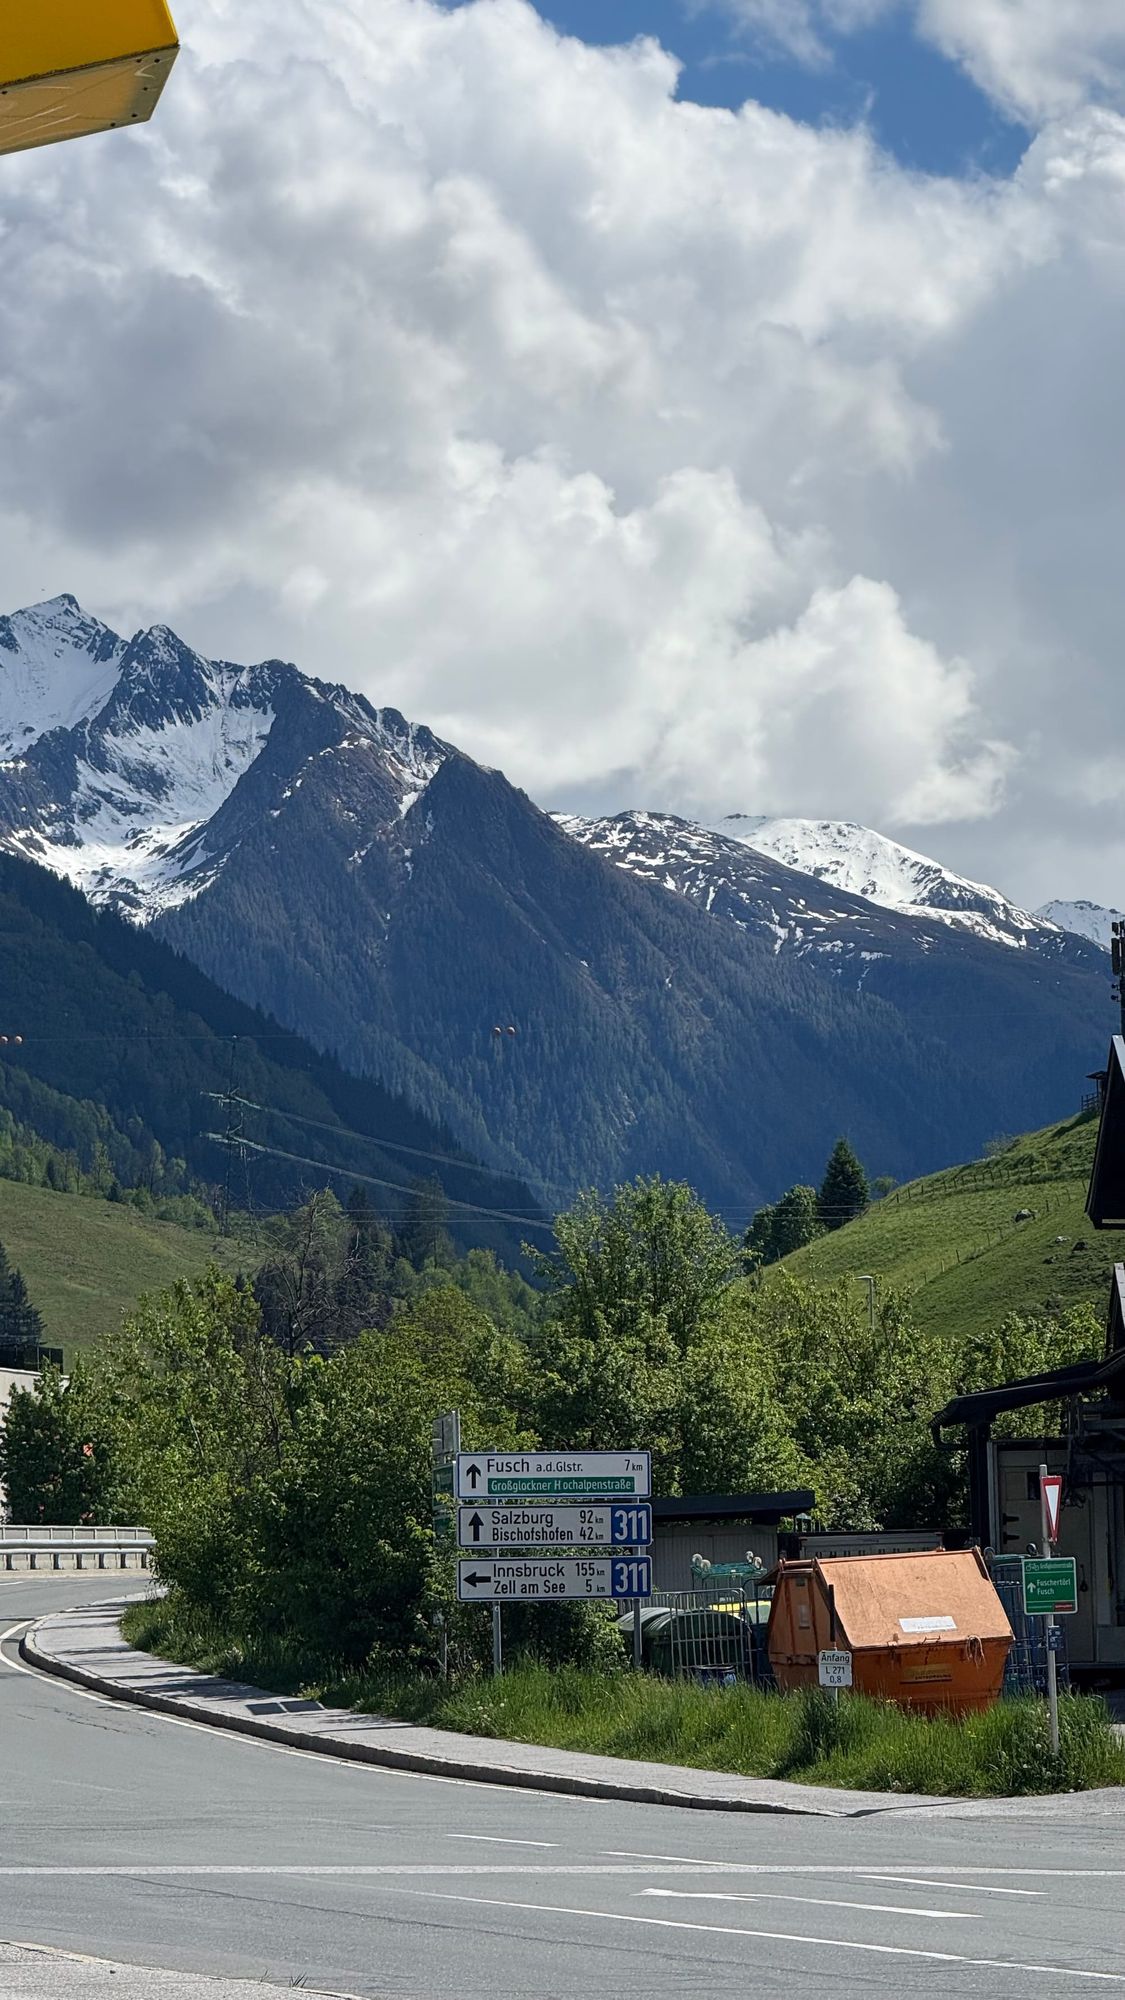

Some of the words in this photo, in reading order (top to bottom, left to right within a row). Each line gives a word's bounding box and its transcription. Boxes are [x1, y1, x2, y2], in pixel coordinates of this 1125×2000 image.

[487, 1458, 530, 1473] Fusch
[624, 1459, 631, 1471] 7
[491, 1479, 551, 1493] Großglockner
[554, 1477, 631, 1491] Hochalpenstraße
[491, 1511, 554, 1527] Salzburg
[579, 1510, 594, 1524] 92
[595, 1516, 604, 1524] km
[614, 1510, 648, 1541] 311
[492, 1527, 573, 1541] Bischofshofen
[579, 1527, 594, 1541] 42
[493, 1563, 565, 1577] Innsbruck
[575, 1562, 595, 1577] 155
[596, 1568, 605, 1576] km
[615, 1562, 648, 1593] 311
[1036, 1578, 1071, 1587] Fuschertörl
[494, 1580, 516, 1594] Zell
[520, 1582, 539, 1594] am
[543, 1580, 566, 1593] See
[585, 1579, 593, 1593] 5
[596, 1585, 606, 1593] km
[821, 1654, 850, 1663] Anfang
[825, 1666, 830, 1674] L
[832, 1666, 845, 1674] 271
[830, 1676, 842, 1684] 0,8
